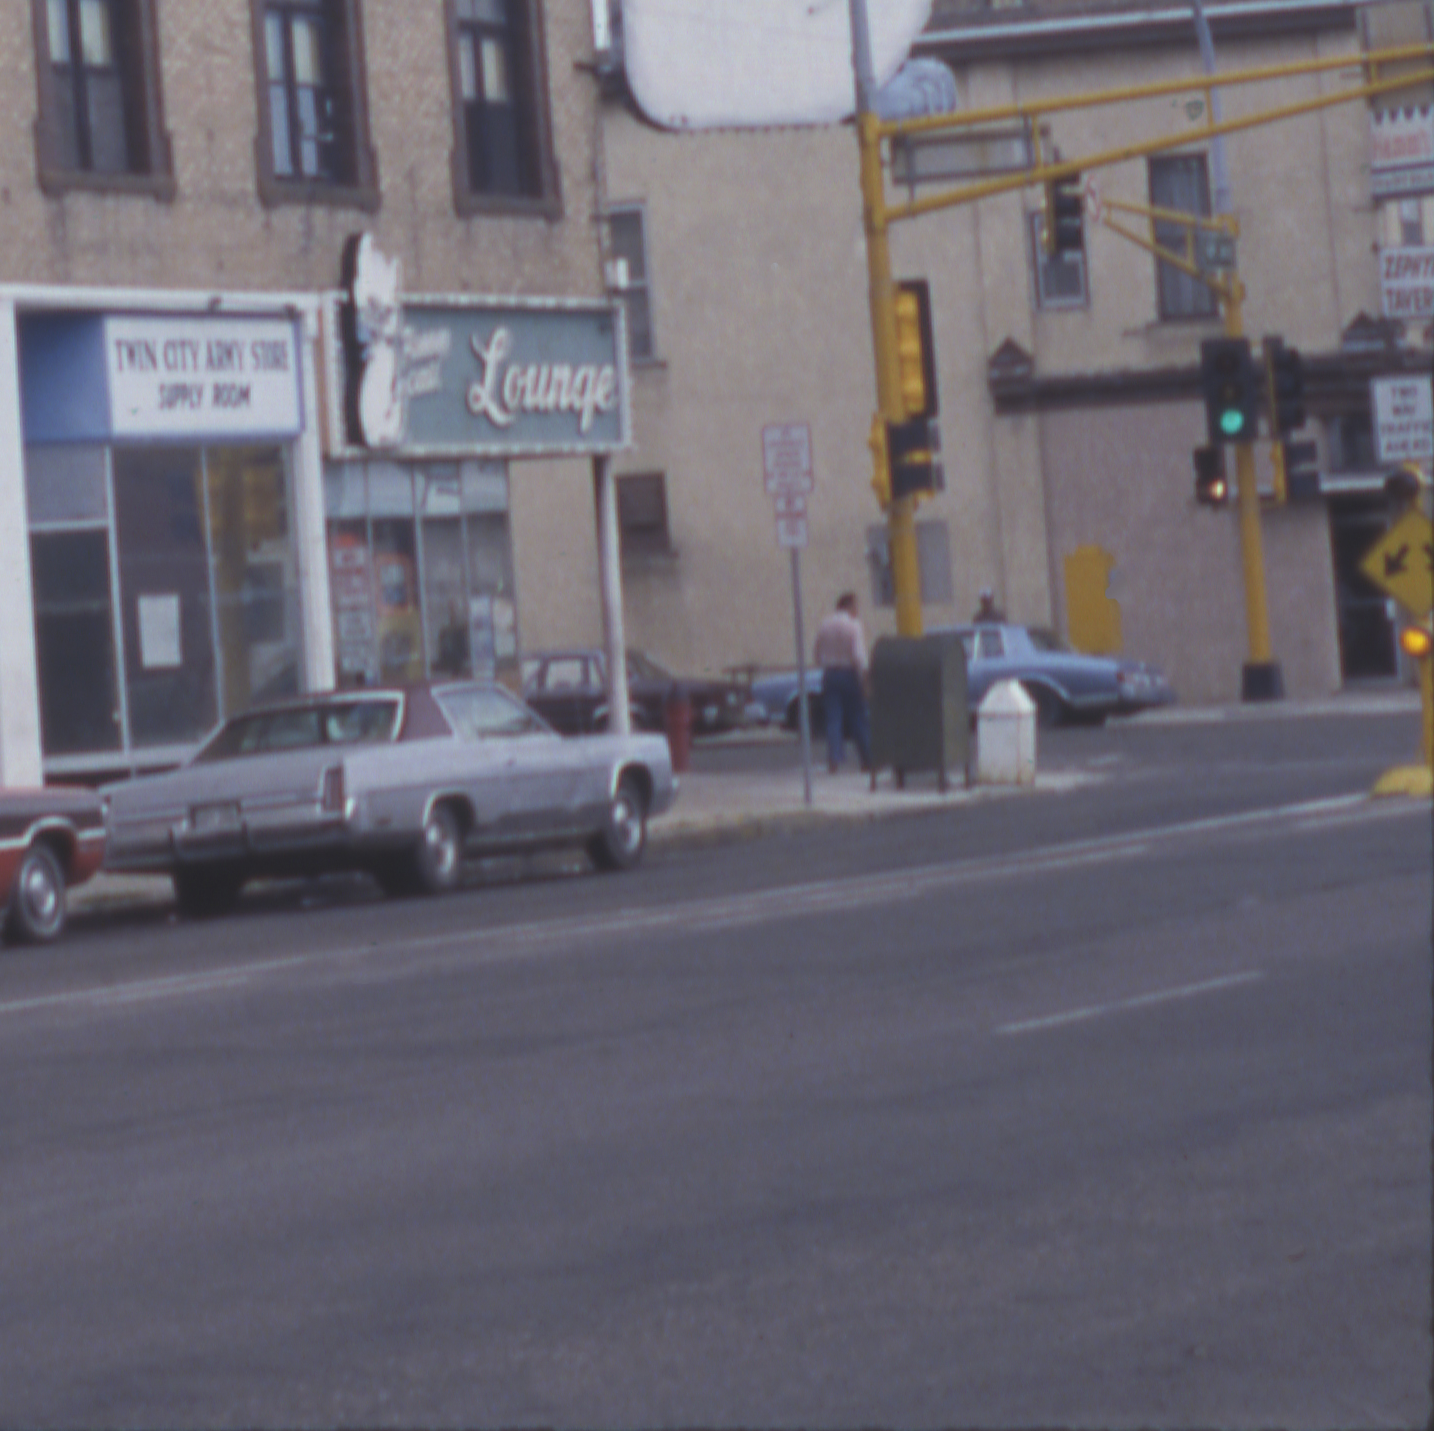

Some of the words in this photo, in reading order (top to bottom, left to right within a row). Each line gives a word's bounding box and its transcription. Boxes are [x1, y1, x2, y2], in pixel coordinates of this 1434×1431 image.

[115, 338, 158, 372] TWIN
[163, 338, 199, 372] CITY
[205, 338, 245, 372] ARMY
[211, 381, 252, 409] ROOM
[466, 324, 615, 433] Lounge
